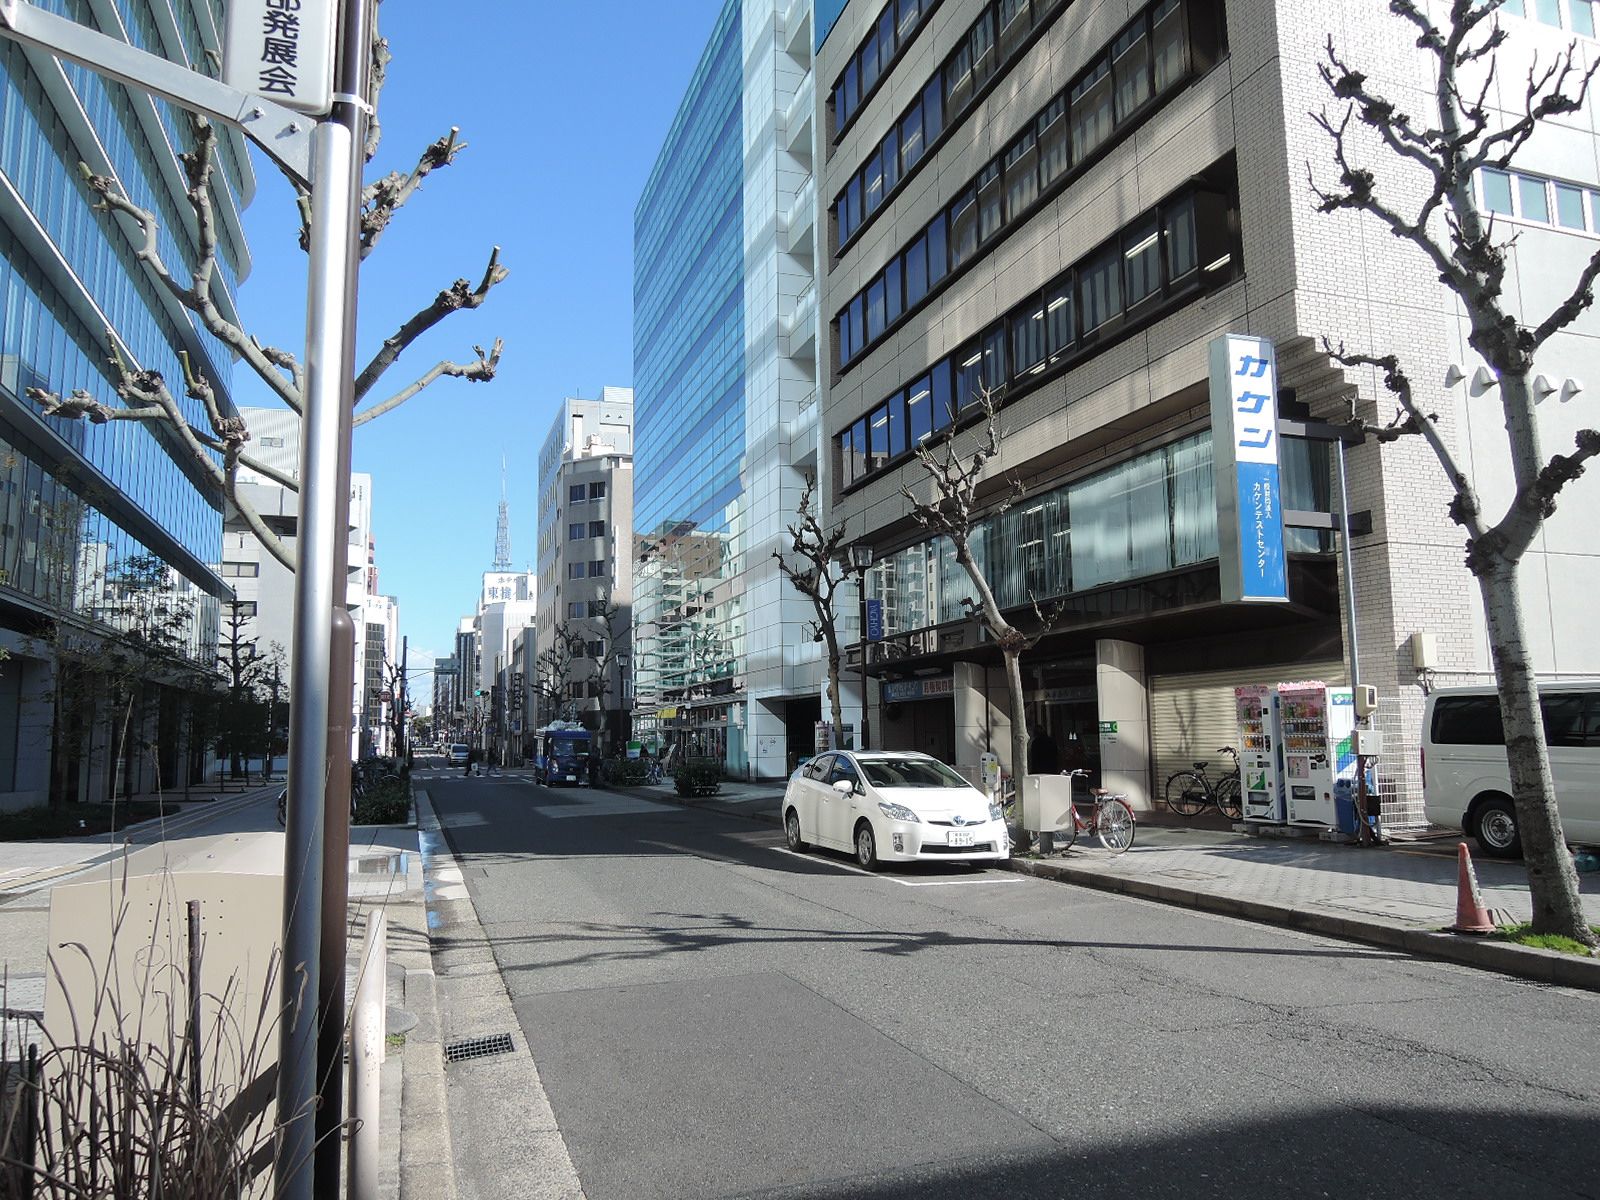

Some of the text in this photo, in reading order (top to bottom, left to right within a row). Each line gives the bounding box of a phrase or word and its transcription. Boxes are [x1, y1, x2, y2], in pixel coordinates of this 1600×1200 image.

[1234, 354, 1273, 448] カケン
[1253, 481, 1266, 578] カケンテストセンター
